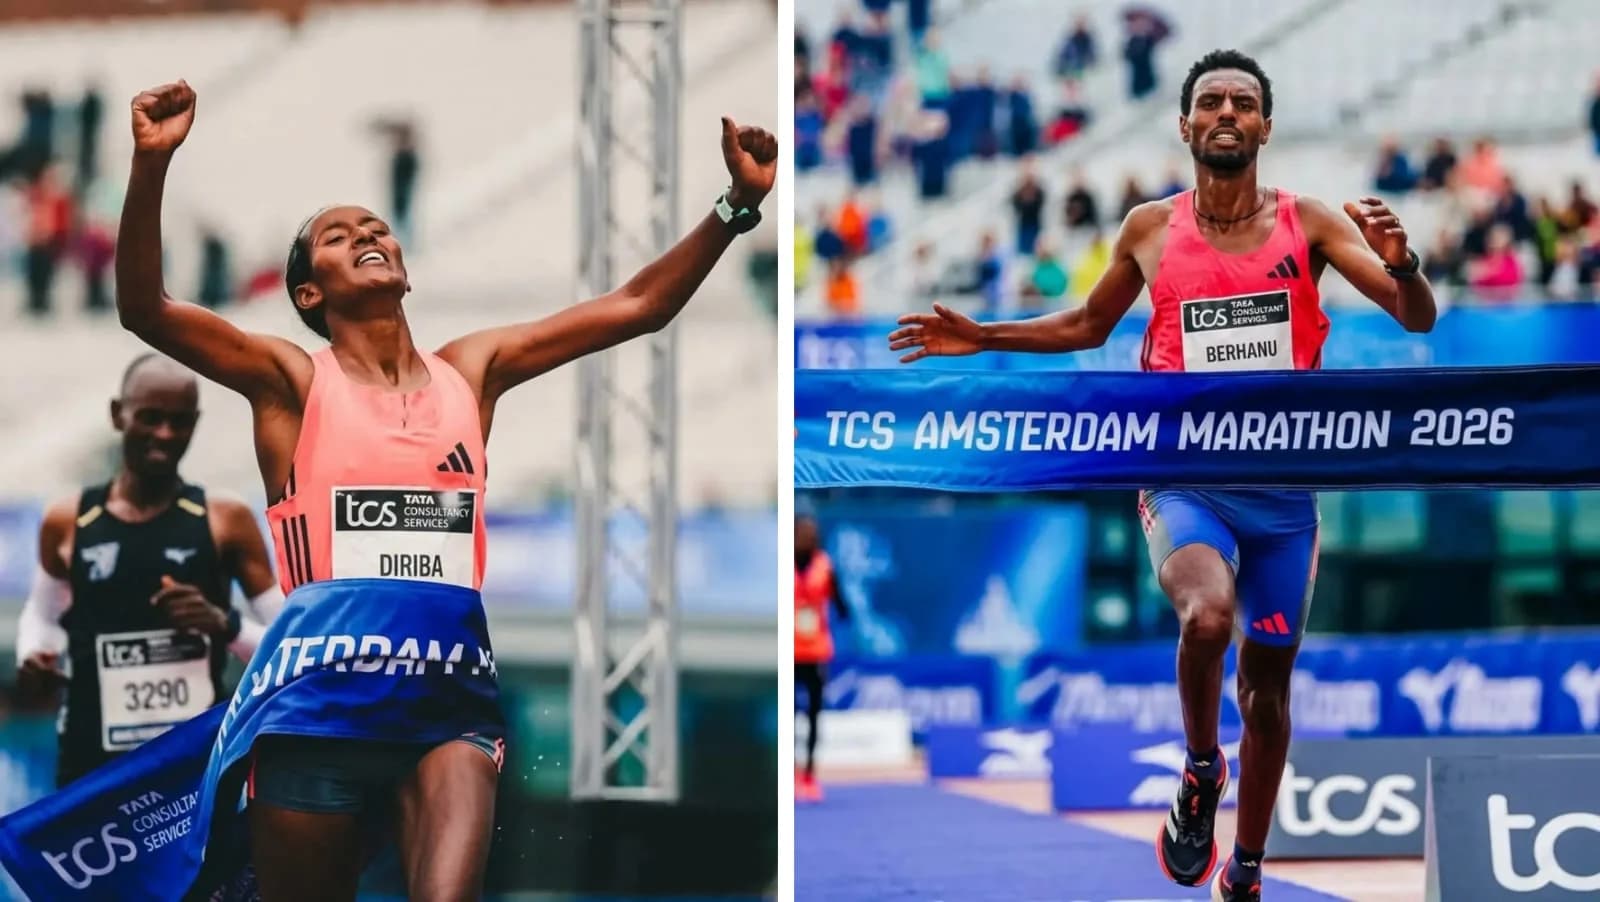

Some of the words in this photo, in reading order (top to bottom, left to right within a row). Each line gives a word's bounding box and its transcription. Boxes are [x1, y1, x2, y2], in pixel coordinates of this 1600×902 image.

[1191, 306, 1228, 329] tcs
[1206, 340, 1278, 363] BERHANU
[826, 410, 896, 451] TCS
[913, 410, 1161, 452] AMSTERDAM
[1177, 409, 1392, 451] MARATHON
[1409, 407, 1515, 446] 2026
[346, 494, 398, 527] tcs
[403, 494, 435, 505] TATA
[403, 506, 470, 518] CONSULTANCY
[403, 518, 449, 529] SERVICES
[379, 553, 444, 578] DIRIBA
[124, 678, 189, 712] 3290
[118, 790, 164, 816] TATA
[132, 790, 199, 833] CONSULTA
[1276, 760, 1421, 837] tcs
[41, 822, 137, 890] tcs
[1487, 793, 1600, 893] tc
